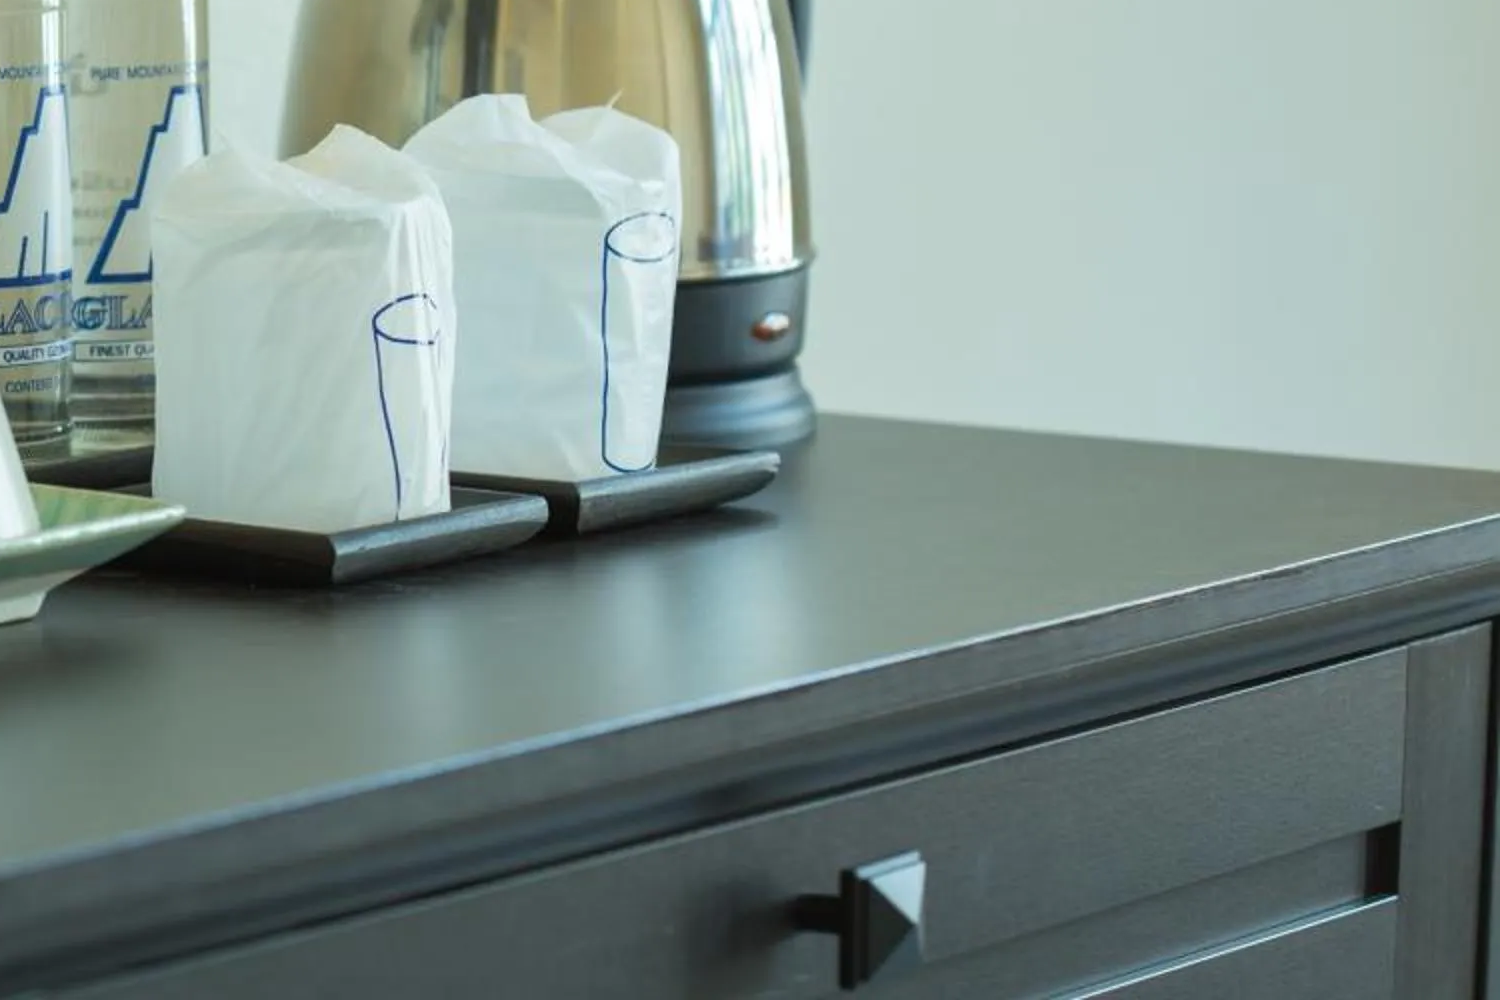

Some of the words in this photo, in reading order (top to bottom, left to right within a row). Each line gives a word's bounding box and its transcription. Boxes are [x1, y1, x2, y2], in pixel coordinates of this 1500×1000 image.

[91, 66, 120, 81] PURE
[127, 61, 182, 78] MOUNTA
[72, 294, 153, 331] GLA
[3, 345, 44, 364] QUALITY
[89, 343, 130, 358] FINEST
